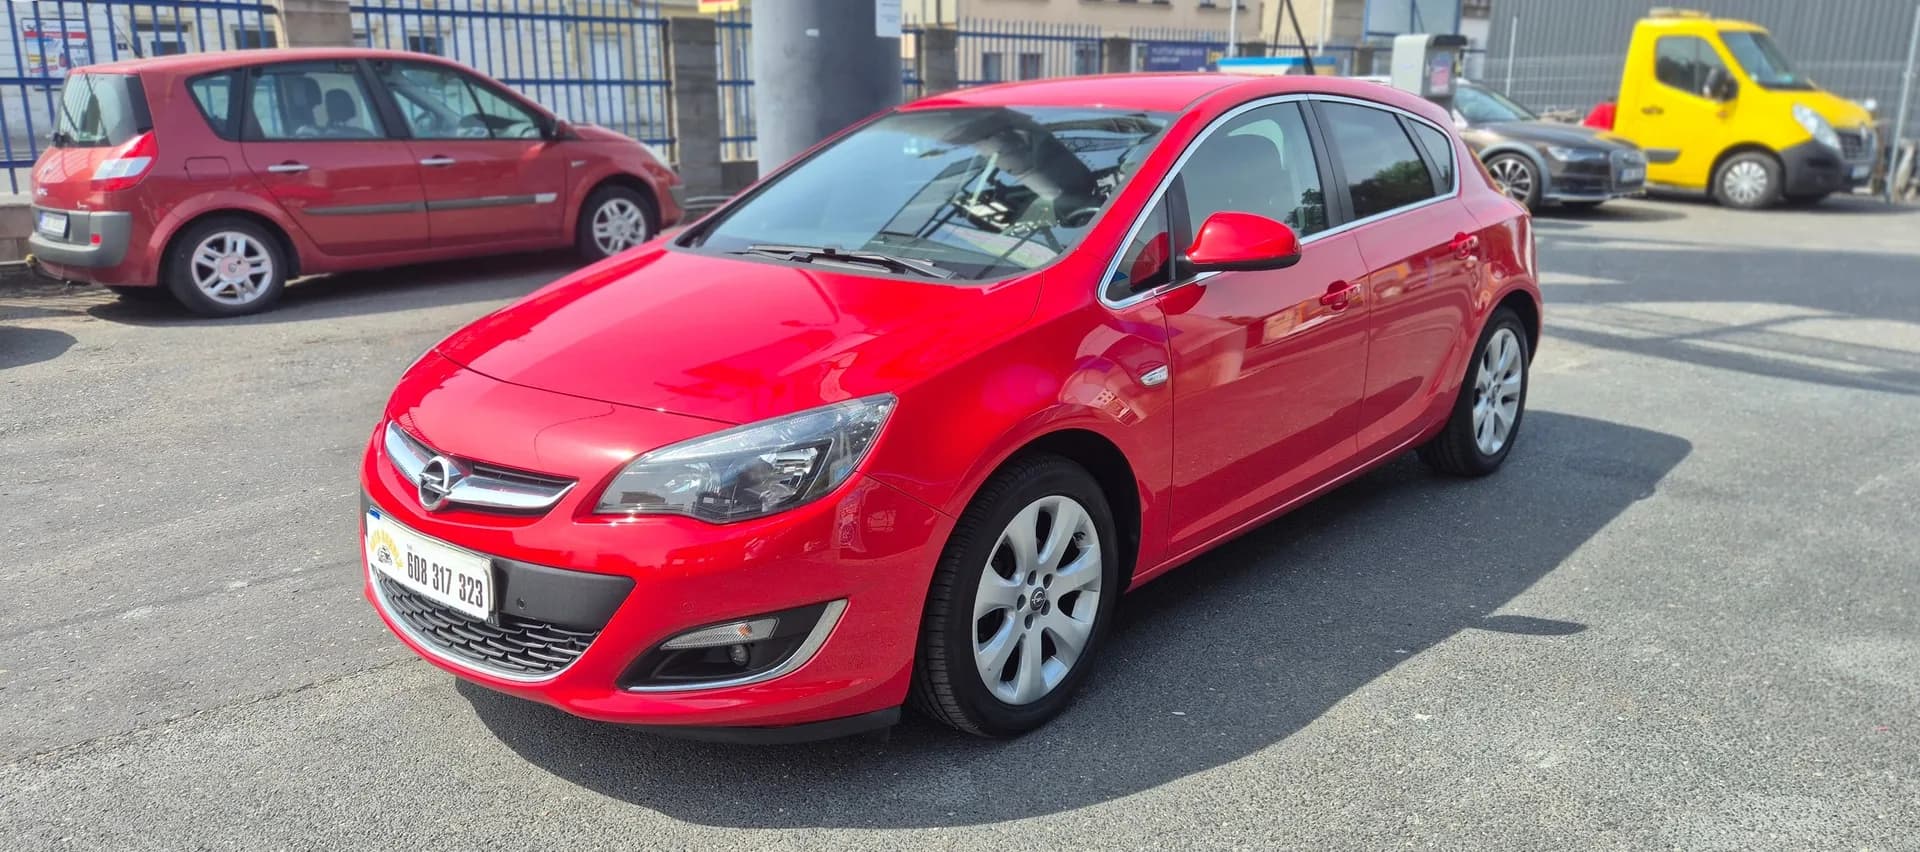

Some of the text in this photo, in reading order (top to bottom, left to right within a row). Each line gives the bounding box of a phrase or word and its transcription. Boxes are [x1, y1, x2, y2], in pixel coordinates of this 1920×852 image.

[407, 551, 484, 609] 608 317 323
